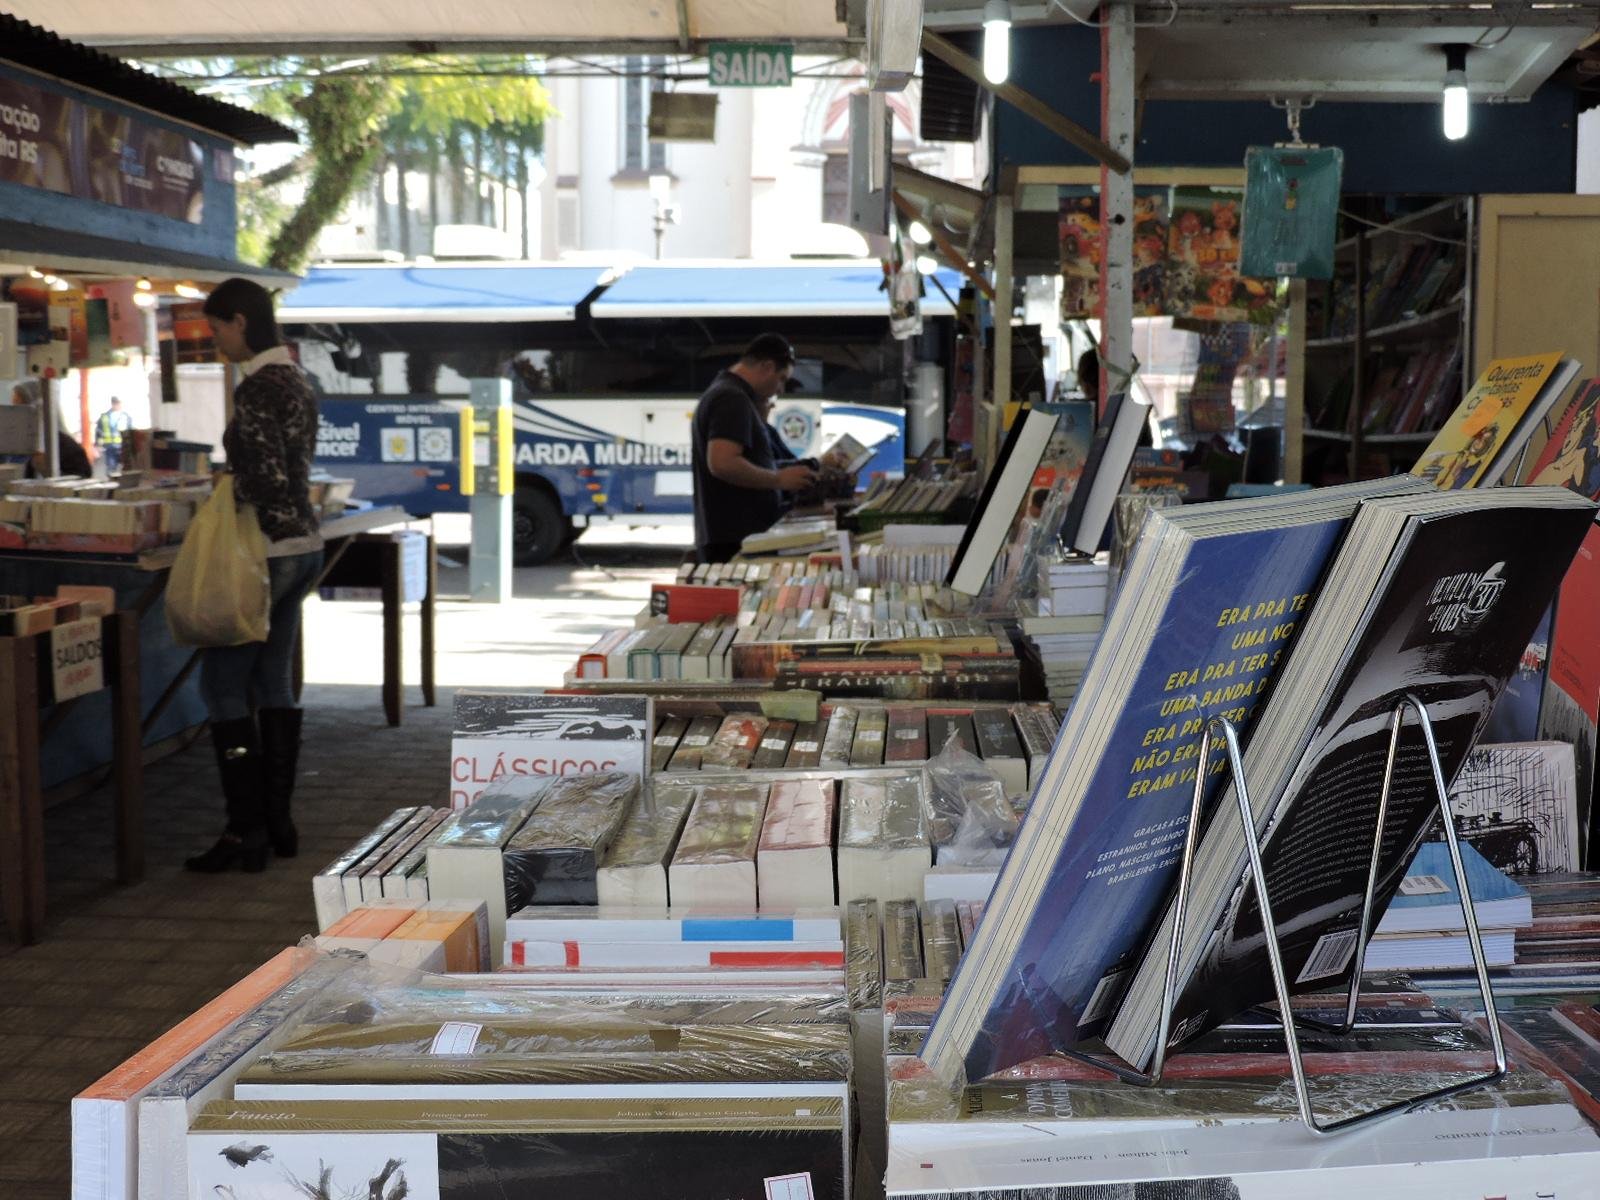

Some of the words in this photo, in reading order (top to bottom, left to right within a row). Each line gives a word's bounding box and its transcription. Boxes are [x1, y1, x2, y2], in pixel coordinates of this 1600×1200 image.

[712, 47, 789, 84] SAÍDA
[595, 444, 692, 465] MUNICI
[1216, 605, 1252, 627] ERA
[1253, 598, 1286, 620] PRA
[1231, 628, 1267, 650] UMA
[1164, 668, 1200, 692] ERA
[1202, 660, 1236, 682] PRA
[1240, 653, 1269, 673] TER
[1160, 694, 1197, 717] UMA
[1200, 680, 1254, 707] BANDA
[1142, 723, 1177, 747] ERA
[1179, 717, 1203, 738] PR
[1130, 748, 1172, 774] NÃO
[1127, 772, 1177, 799] ERAM
[228, 1110, 298, 1121] Fausto
